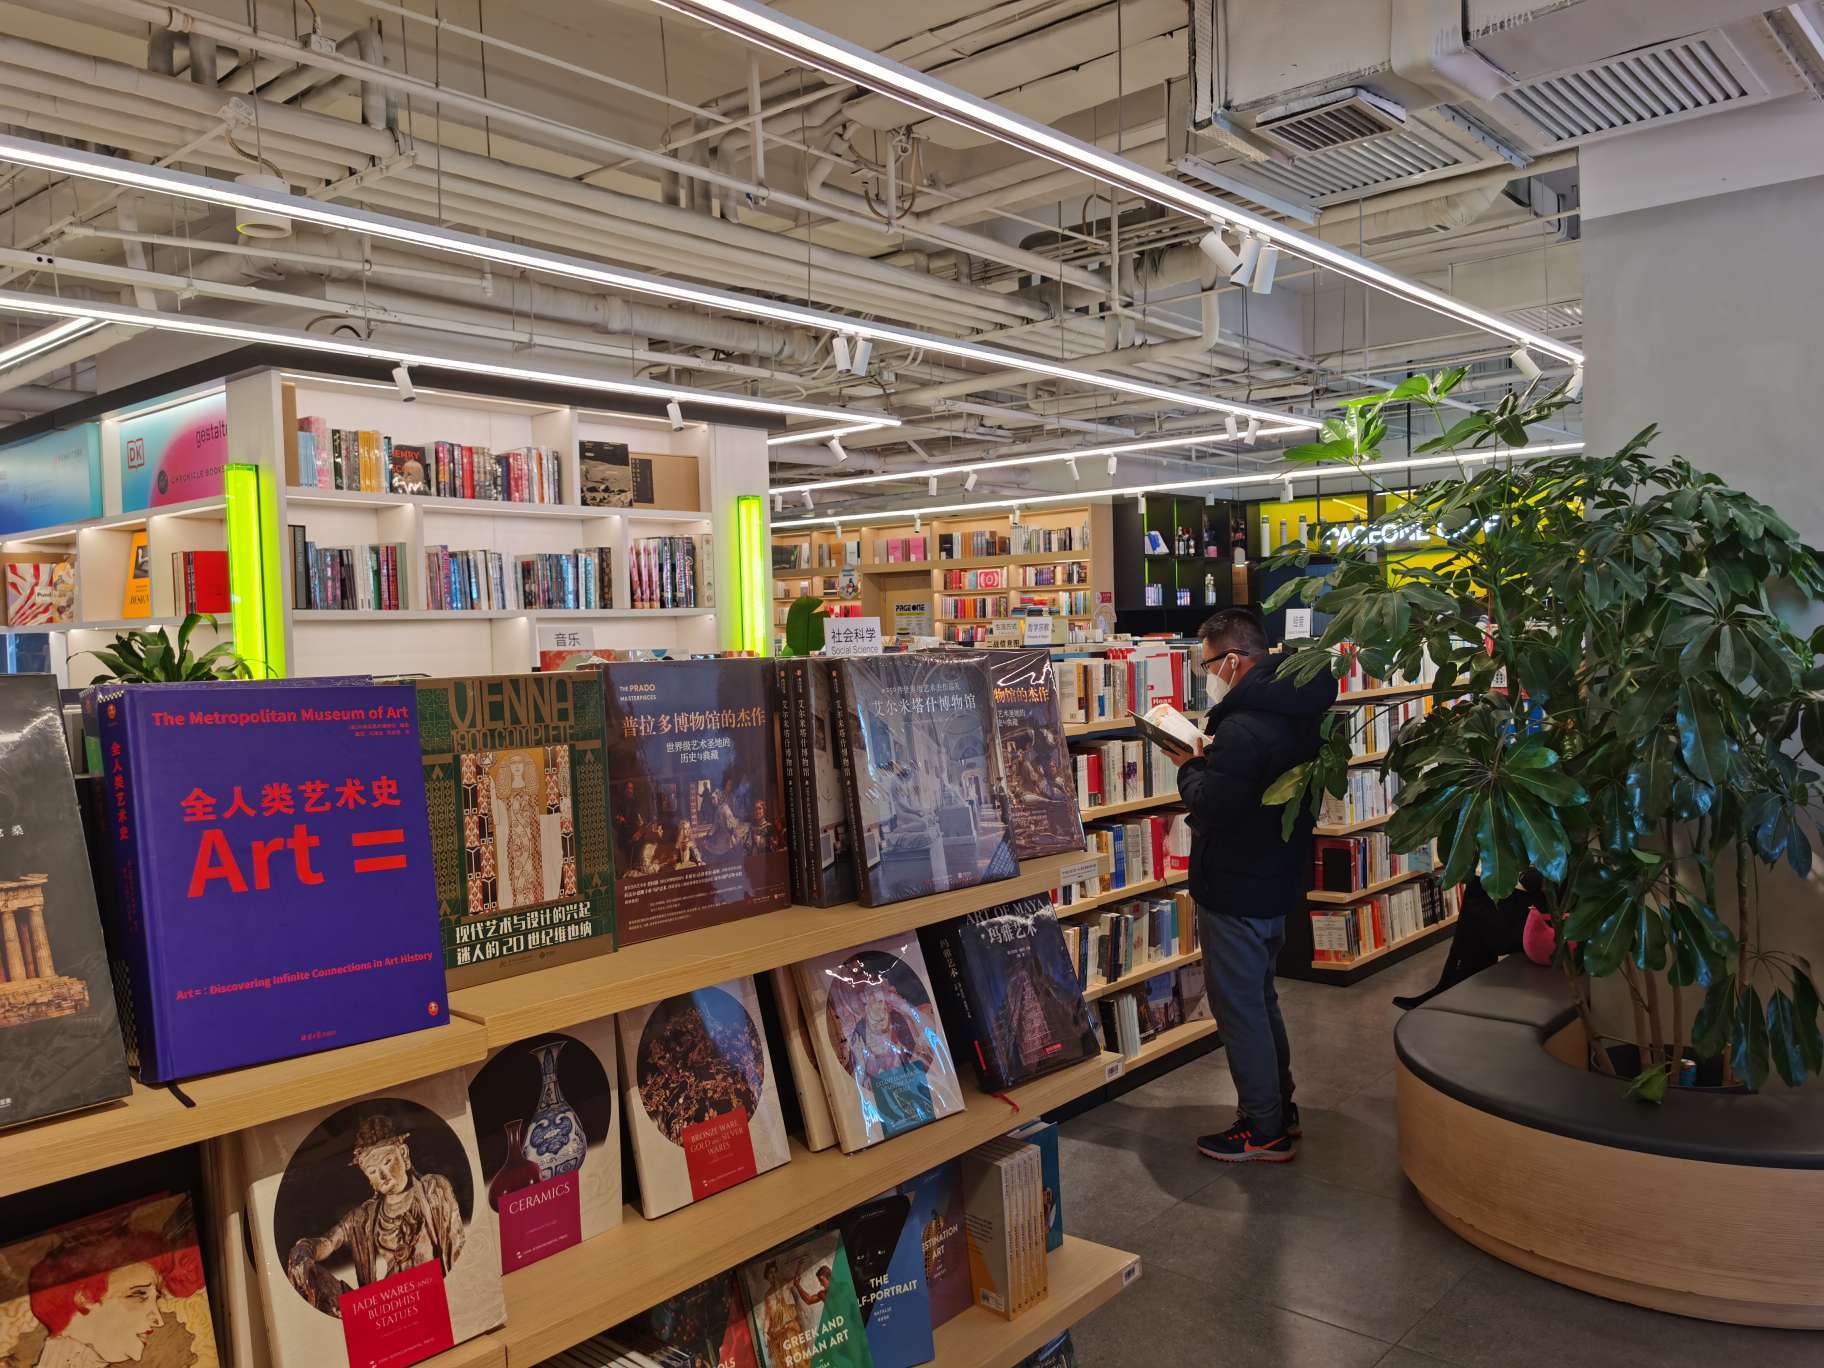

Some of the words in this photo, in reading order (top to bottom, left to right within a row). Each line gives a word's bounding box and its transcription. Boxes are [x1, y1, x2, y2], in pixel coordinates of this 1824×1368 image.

[129, 445, 142, 462] DK
[553, 631, 582, 647] 音乐
[831, 626, 876, 643] 社会科学
[831, 646, 852, 656] Social
[853, 645, 879, 654] Science
[619, 694, 657, 702] MASTERPIECES
[629, 683, 656, 692] PRADO
[151, 711, 185, 726] The
[188, 707, 297, 727] Metropolitan
[300, 707, 365, 722] Museum
[368, 705, 385, 719] of
[386, 705, 409, 719] Art
[447, 677, 574, 729] VIENNA
[872, 692, 977, 718] 艾尔米塔什博物馆
[623, 706, 767, 738] 普拉多博物馆的杰作
[451, 728, 491, 755] 1900
[495, 722, 577, 752] COMPLETE
[666, 736, 731, 753] 世界级艺术圣地的
[111, 741, 129, 841] 全人类艺术史
[181, 775, 401, 822] 全人类艺术史
[187, 823, 325, 898] Art
[351, 829, 407, 874] =
[455, 901, 591, 944] 现代艺术与设计的兴起
[966, 909, 990, 927] ART
[994, 904, 1010, 917] OF
[1013, 898, 1046, 915] MAYA
[988, 921, 1038, 944] 玛雅艺术
[209, 977, 272, 995] Discovering
[273, 971, 310, 985] Infinite
[311, 960, 372, 978] Connections
[373, 958, 383, 968] in
[384, 957, 399, 967] Art
[400, 951, 433, 965] History
[718, 1119, 738, 1131] WARE
[690, 1138, 711, 1153] GOLD
[707, 1141, 730, 1155] WARES
[508, 1182, 570, 1215] CERAMICS
[932, 1245, 945, 1261] ART
[869, 1273, 889, 1288] THE
[352, 1295, 378, 1315] JADE
[380, 1280, 416, 1301] WARES
[368, 1291, 422, 1319] BUDDHIST
[857, 1280, 918, 1308] LF-PORTRAIT
[375, 1305, 419, 1329] STATUES
[783, 1328, 819, 1350] GREEK
[820, 1315, 845, 1334] AND
[785, 1341, 828, 1367] ROMAN
[829, 1329, 849, 1348] ART
